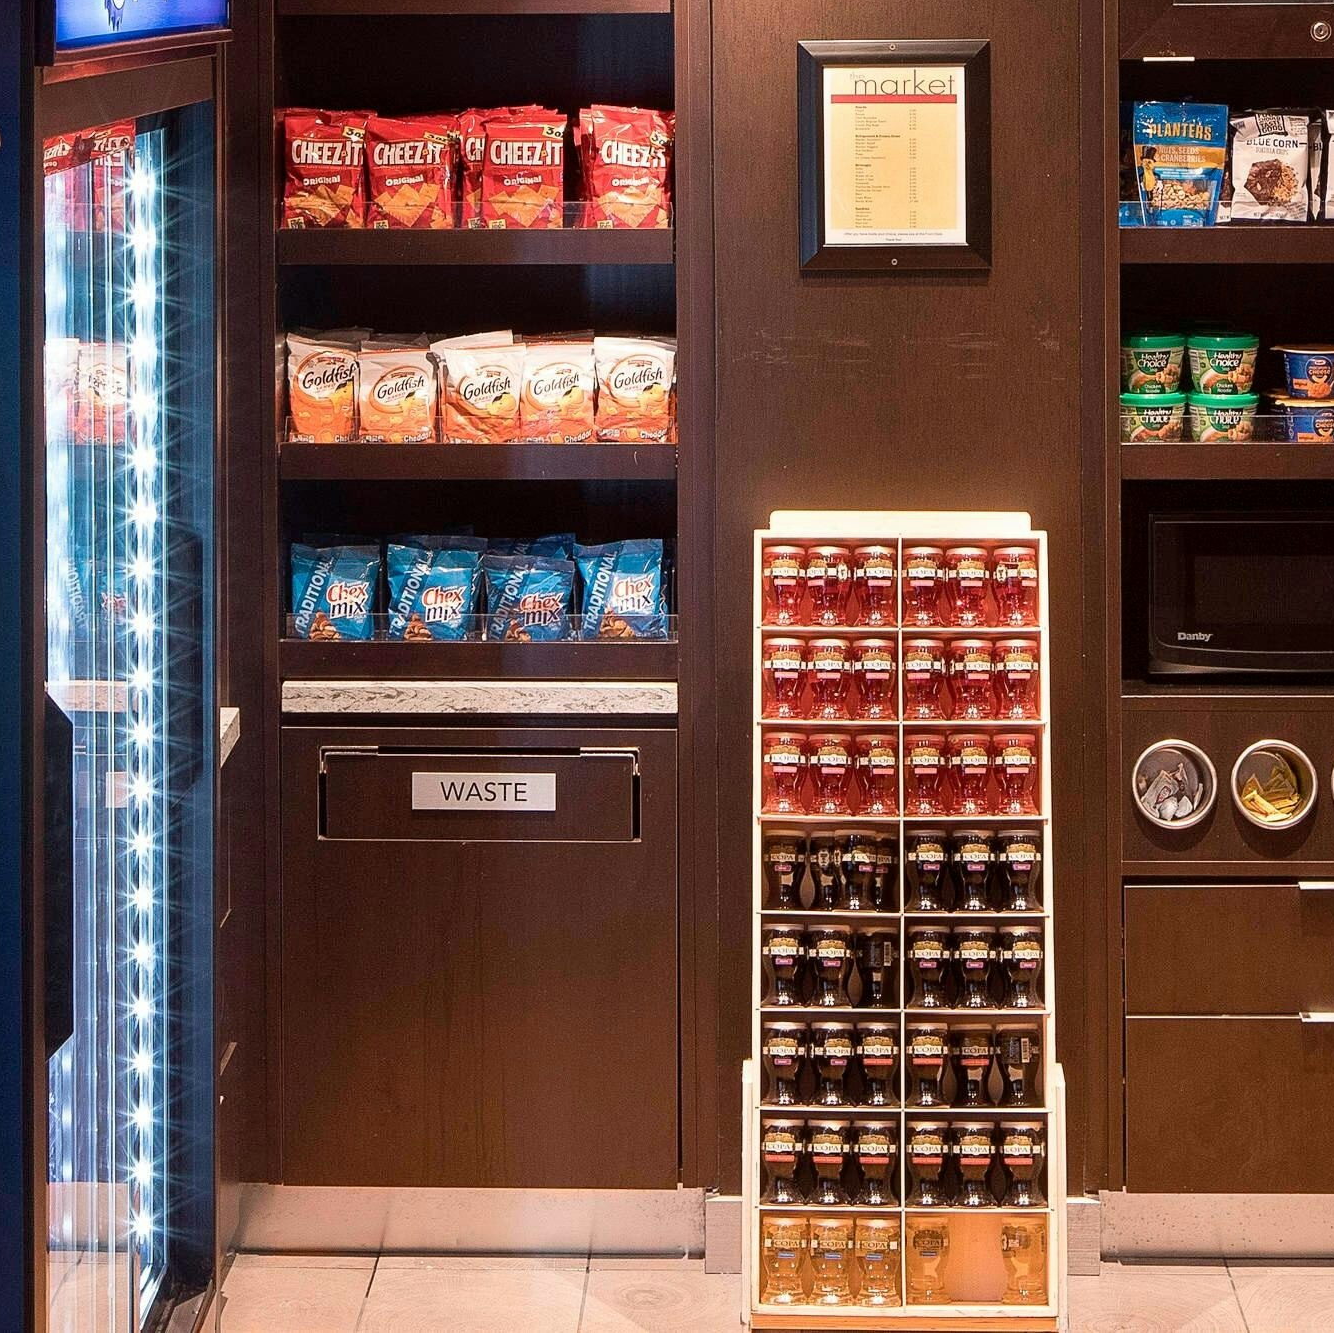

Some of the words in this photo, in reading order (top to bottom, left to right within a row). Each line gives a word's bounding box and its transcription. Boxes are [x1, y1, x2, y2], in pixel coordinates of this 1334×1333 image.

[854, 69, 955, 96] market
[1260, 120, 1281, 129] TASTE
[1148, 122, 1213, 141] PLANTERS
[1247, 138, 1271, 147] BLUE
[1273, 137, 1299, 148] CORN
[1178, 147, 1199, 155] SEEDS
[1161, 154, 1206, 163] CRANBERRIES
[1137, 358, 1167, 368] Choice
[1210, 357, 1240, 368] Choice
[613, 367, 663, 389] Goldfish
[377, 376, 425, 399] Goldfish
[533, 372, 580, 396] Goldfish
[463, 376, 512, 401] Goldfish
[564, 429, 593, 443] Cheddar
[613, 575, 654, 597] Chex
[327, 582, 369, 603] Chex
[422, 586, 466, 604] Chex
[584, 551, 618, 631] TRADITIONAL
[519, 592, 565, 610] Chex
[619, 594, 655, 613] mix
[330, 599, 366, 619] mix
[425, 602, 463, 622] mix
[524, 607, 561, 627] mix
[1177, 632, 1214, 642] Danby
[913, 756, 938, 764] COPA
[964, 756, 988, 764] COPA
[1005, 756, 1030, 764] COPA
[440, 781, 528, 802] WASTE
[771, 854, 795, 862] COPA
[920, 853, 943, 861] COPA
[963, 853, 988, 861] COPA
[1010, 853, 1034, 861] COPA
[771, 948, 796, 956] COPA
[819, 949, 843, 957] COPA
[915, 950, 940, 958] COPA
[961, 950, 987, 958] COPA
[1015, 950, 1040, 958] COPA
[771, 1048, 795, 1056] COPA
[826, 1048, 850, 1056] COPA
[865, 1047, 891, 1055] COPA
[915, 1047, 941, 1055] COPA
[962, 1048, 988, 1056] COPA
[766, 1144, 791, 1152] COPA
[814, 1145, 839, 1153] COPA
[860, 1145, 886, 1153] COPA
[914, 1145, 940, 1153] COPA
[962, 1146, 988, 1154] COPA
[1005, 1145, 1029, 1153] COPA
[774, 1240, 799, 1248] COPA
[819, 1240, 846, 1248] COPA
[862, 1241, 887, 1249] COPA
